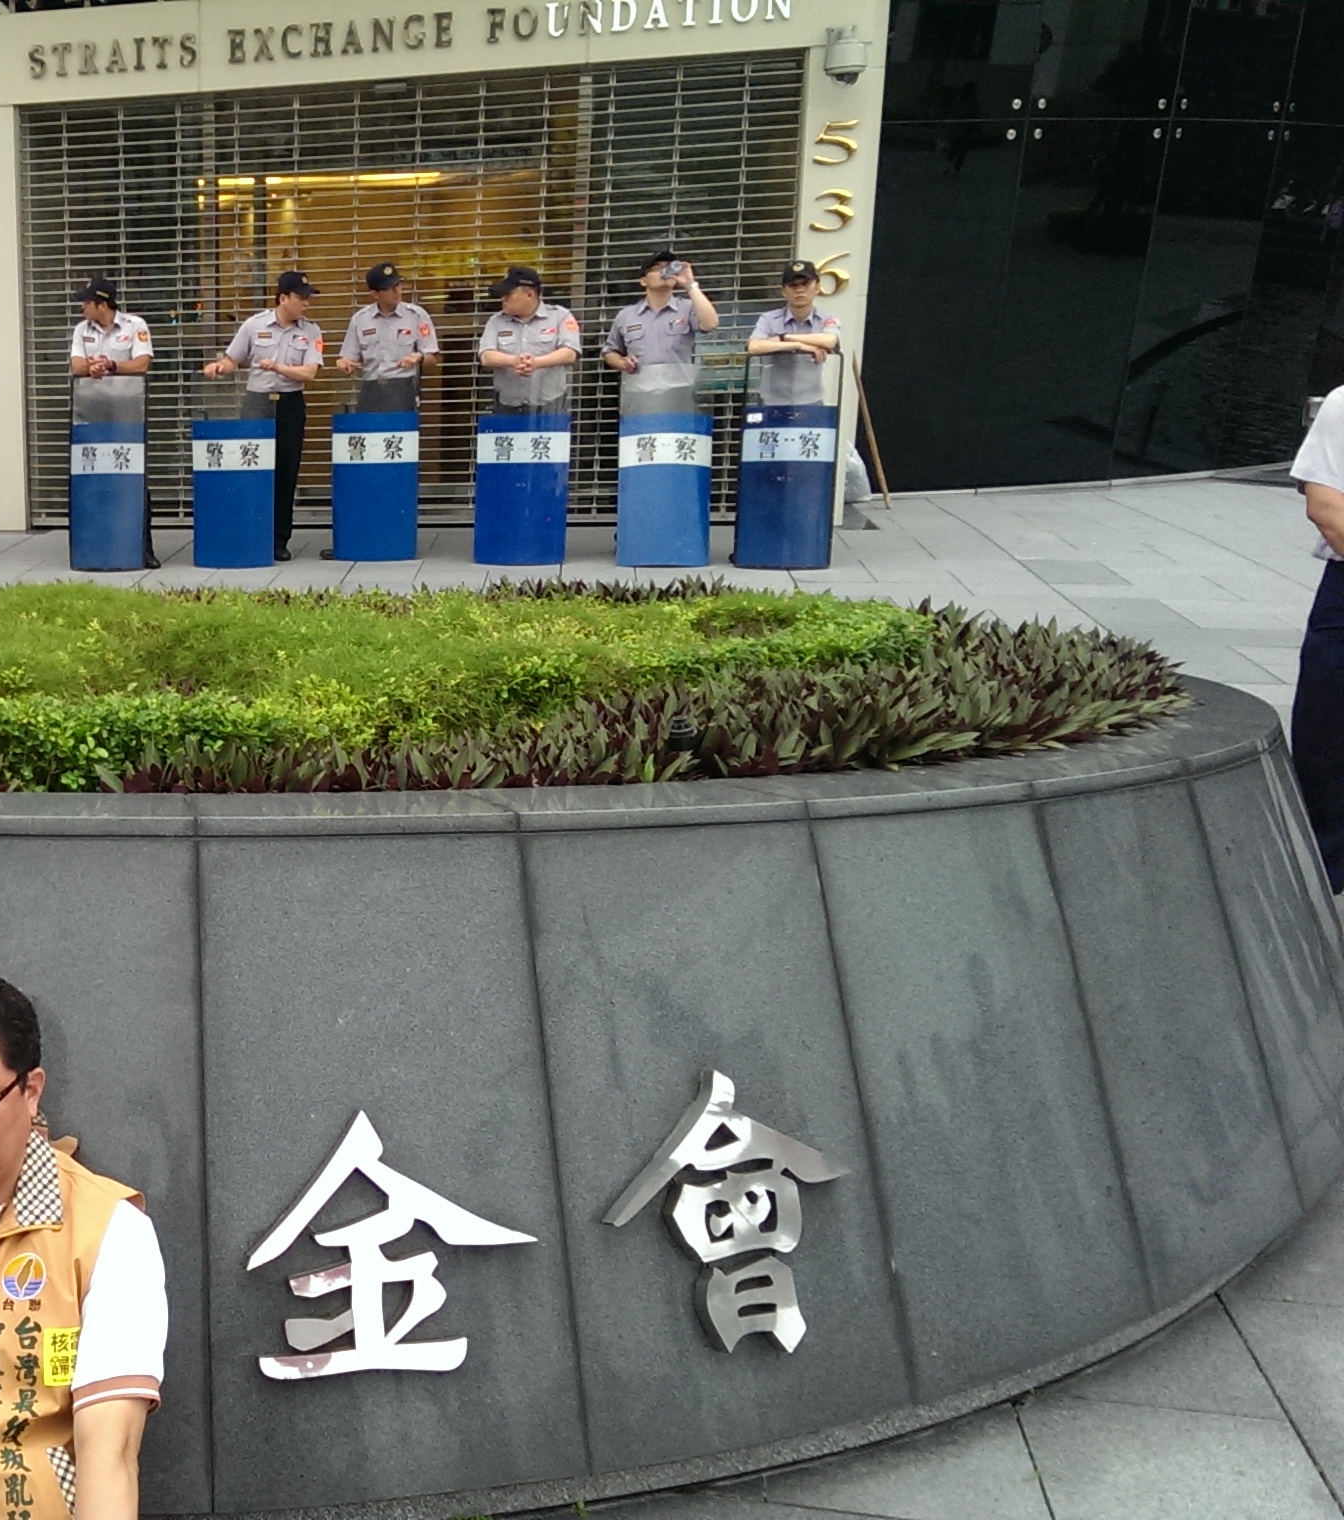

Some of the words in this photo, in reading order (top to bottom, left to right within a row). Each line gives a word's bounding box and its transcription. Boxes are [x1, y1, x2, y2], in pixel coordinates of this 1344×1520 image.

[28, 33, 198, 78] STRAITS
[227, 11, 453, 64] EXCHANGE
[487, 0, 792, 44] FOUNDATION
[205, 442, 260, 469] 警察
[347, 435, 404, 461] 警察
[493, 435, 552, 461] 警察
[636, 436, 697, 463] 警察
[758, 430, 822, 459] 警察
[81, 445, 131, 471] 警察
[2, 1298, 41, 1312] 台聯
